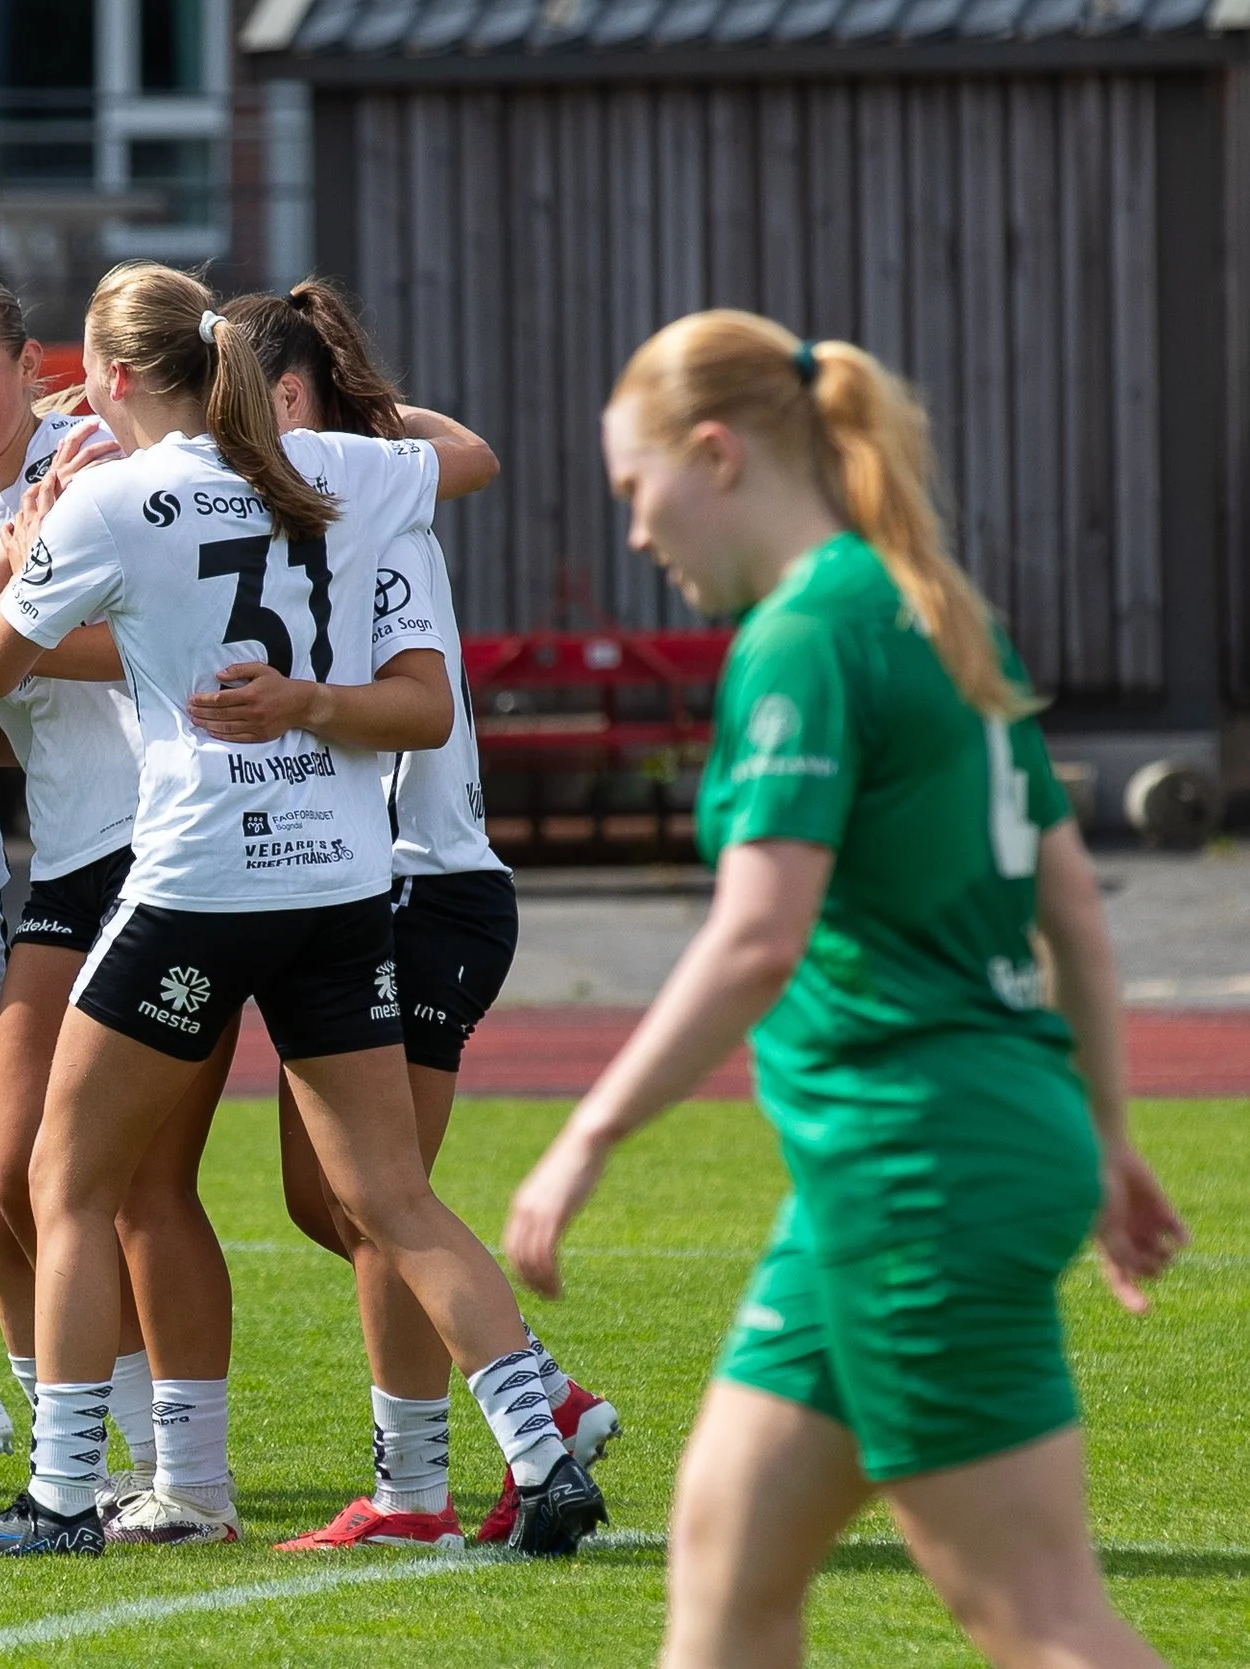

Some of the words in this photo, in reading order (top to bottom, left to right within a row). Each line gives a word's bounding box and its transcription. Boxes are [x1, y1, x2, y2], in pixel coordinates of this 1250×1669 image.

[199, 534, 335, 691] 31
[397, 617, 433, 632] Sogn
[228, 754, 266, 784] Hov
[245, 840, 327, 858] VEGARD'S
[138, 1000, 201, 1034] mesta
[370, 1002, 401, 1021] mest
